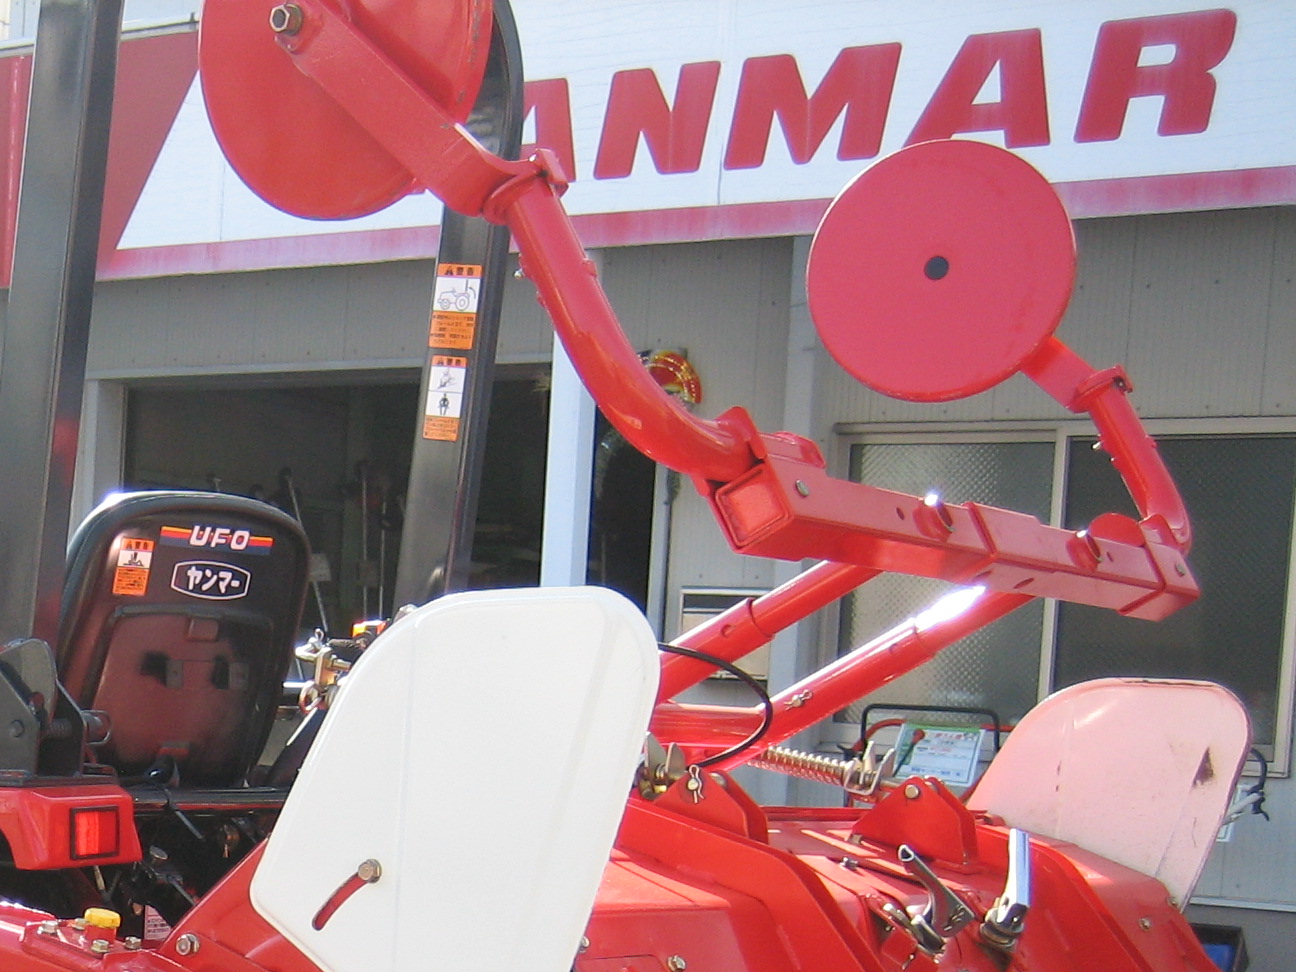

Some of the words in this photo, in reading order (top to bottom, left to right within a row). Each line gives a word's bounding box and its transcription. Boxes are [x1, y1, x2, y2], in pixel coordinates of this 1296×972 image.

[519, 8, 1238, 183] ANMAR
[190, 525, 251, 551] UFO
[187, 566, 240, 593] ヤンマー
